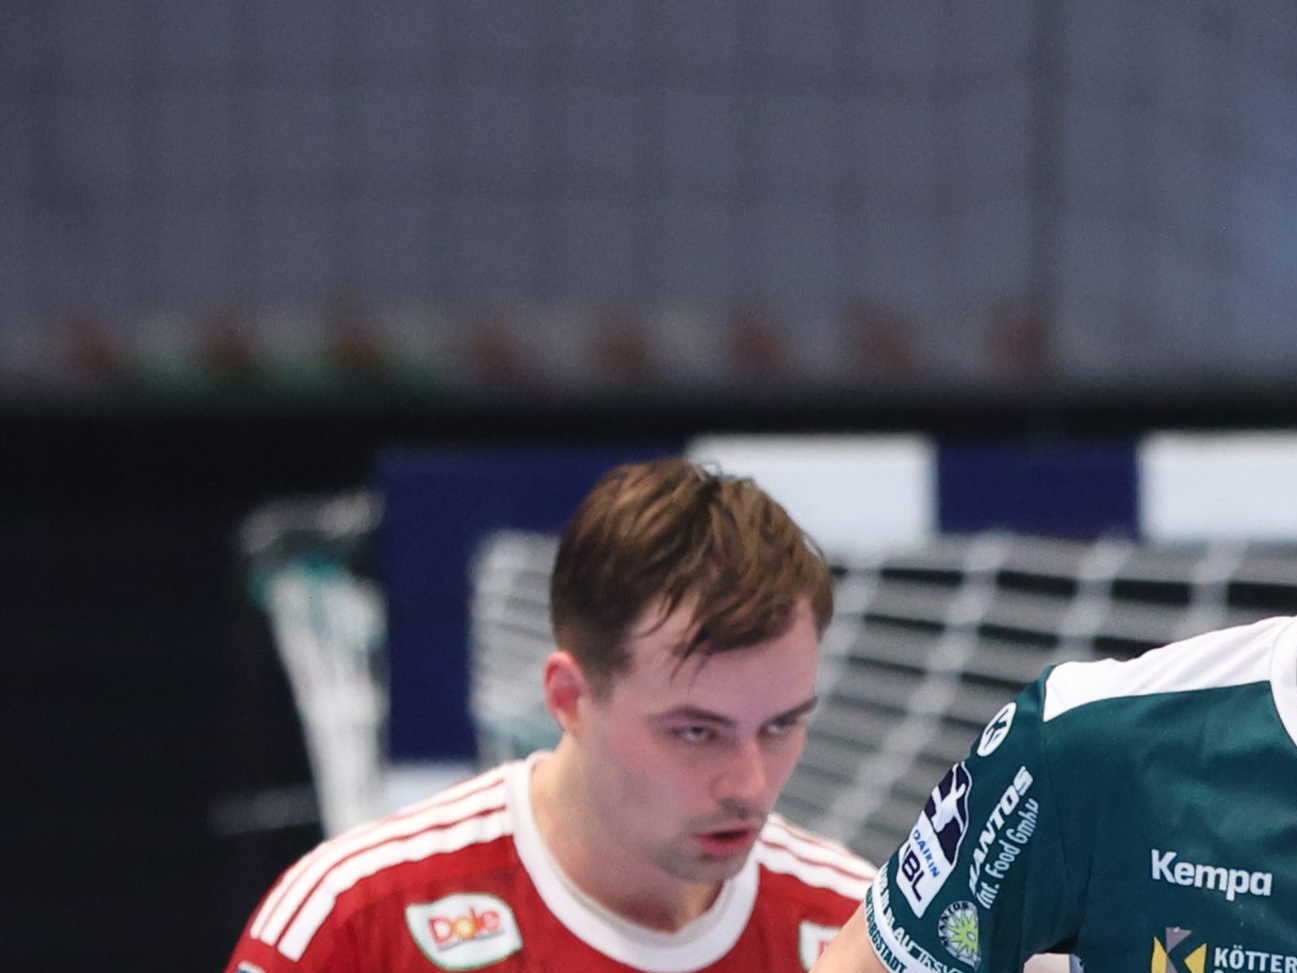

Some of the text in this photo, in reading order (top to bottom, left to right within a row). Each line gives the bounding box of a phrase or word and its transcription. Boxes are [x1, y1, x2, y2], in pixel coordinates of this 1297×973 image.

[913, 829, 940, 878] DAIKIN
[986, 840, 1021, 880] Food
[1151, 849, 1273, 901] Kempa
